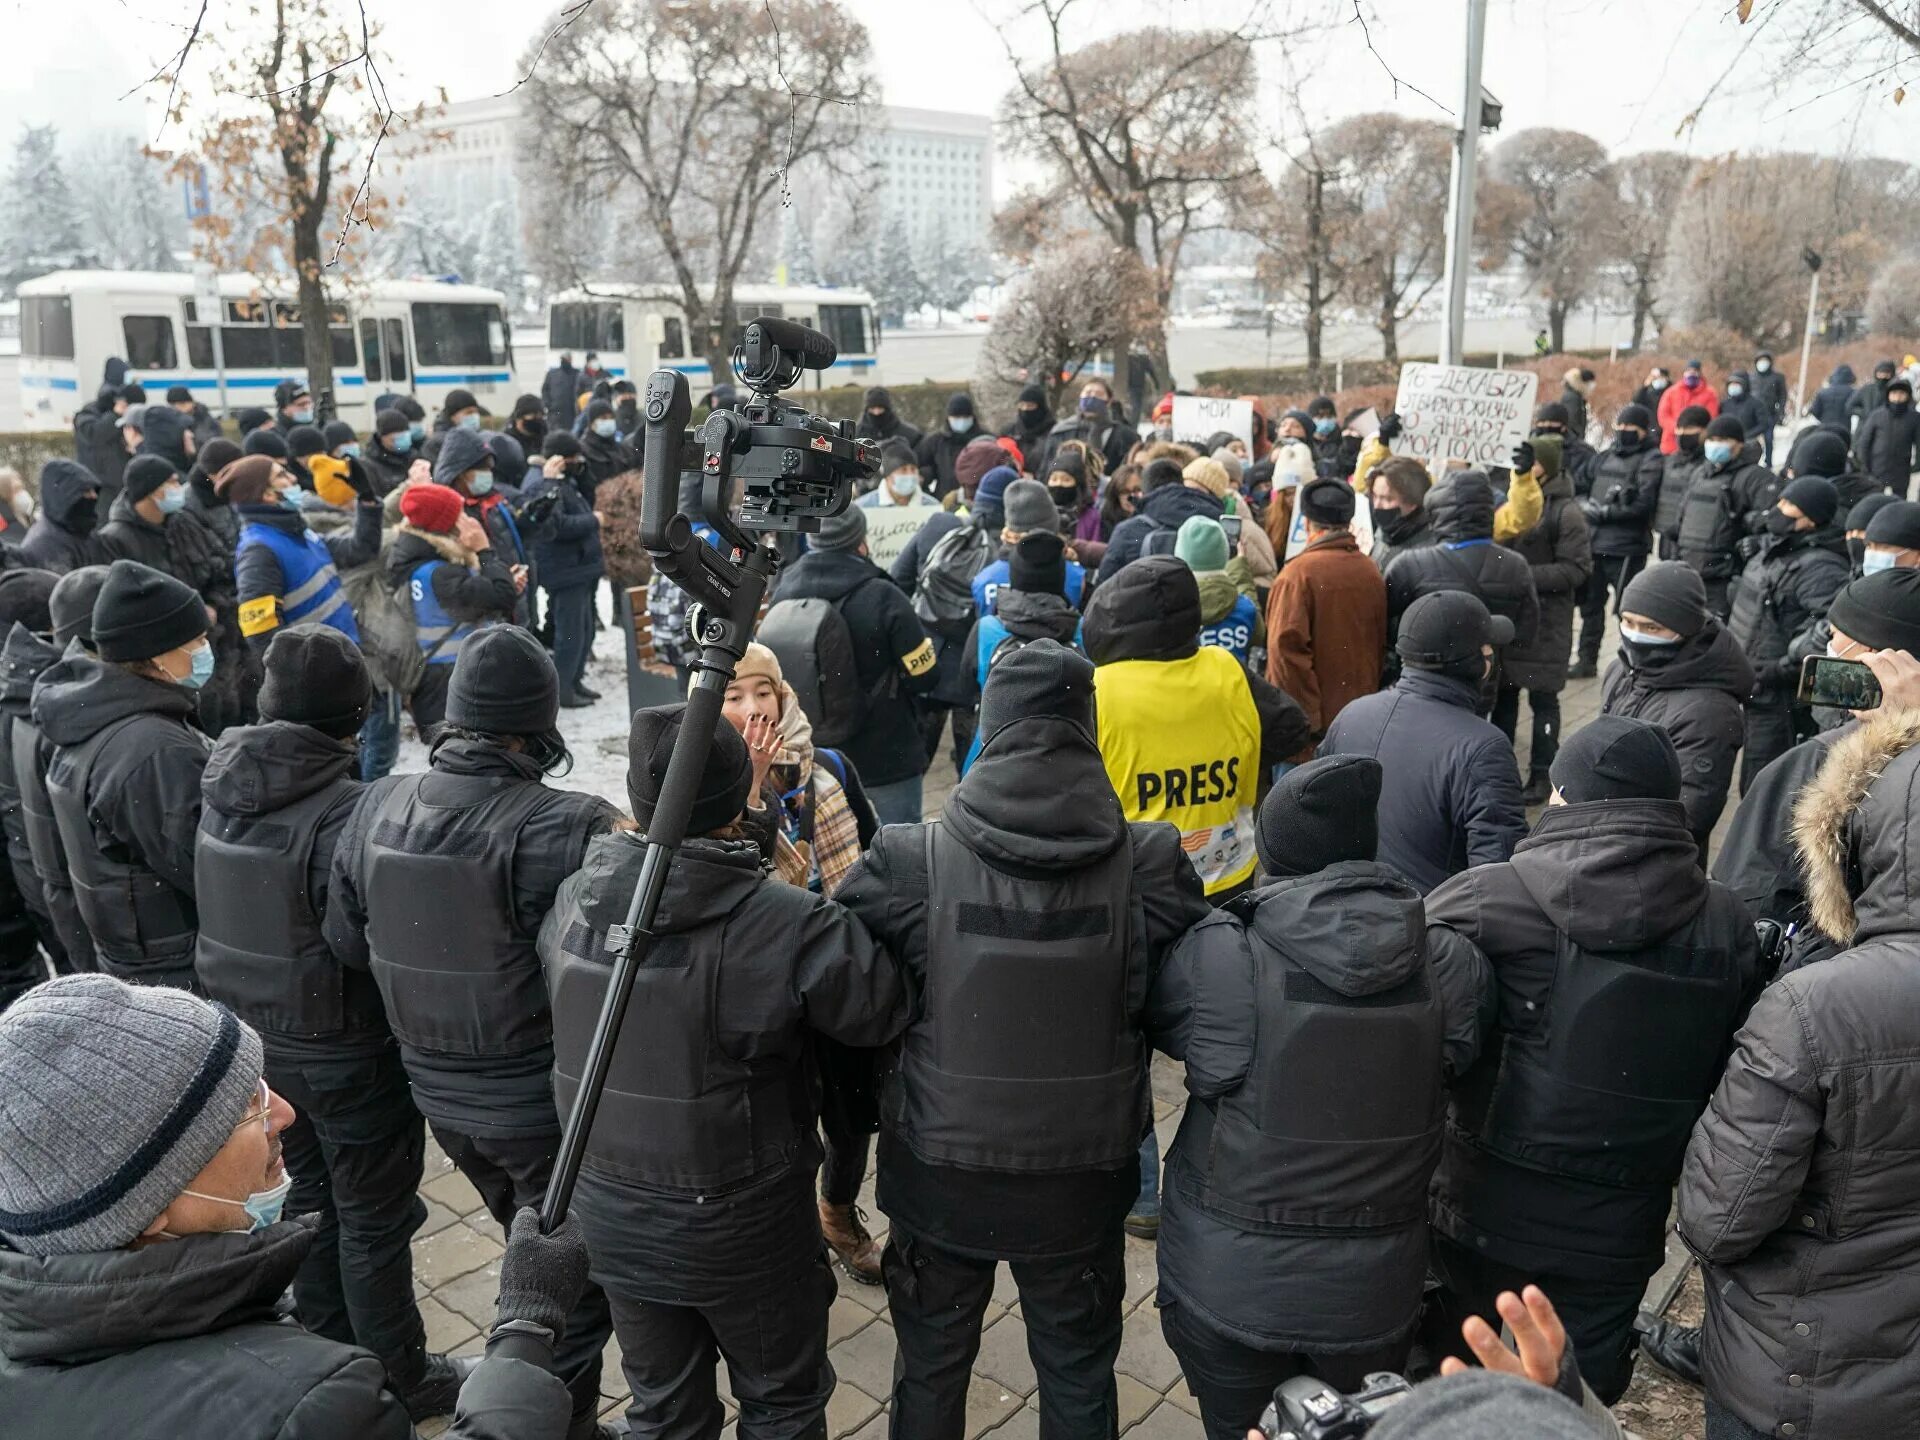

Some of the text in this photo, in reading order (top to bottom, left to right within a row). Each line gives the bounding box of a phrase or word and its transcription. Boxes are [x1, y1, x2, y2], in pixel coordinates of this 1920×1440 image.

[1434, 369, 1530, 399] ДЕКАБРЯ
[1431, 416, 1504, 442] ЯНВАРЯ
[1447, 438, 1505, 463] ГОЛОС
[1199, 625, 1249, 650] ESS
[1137, 756, 1240, 812] PRESS
